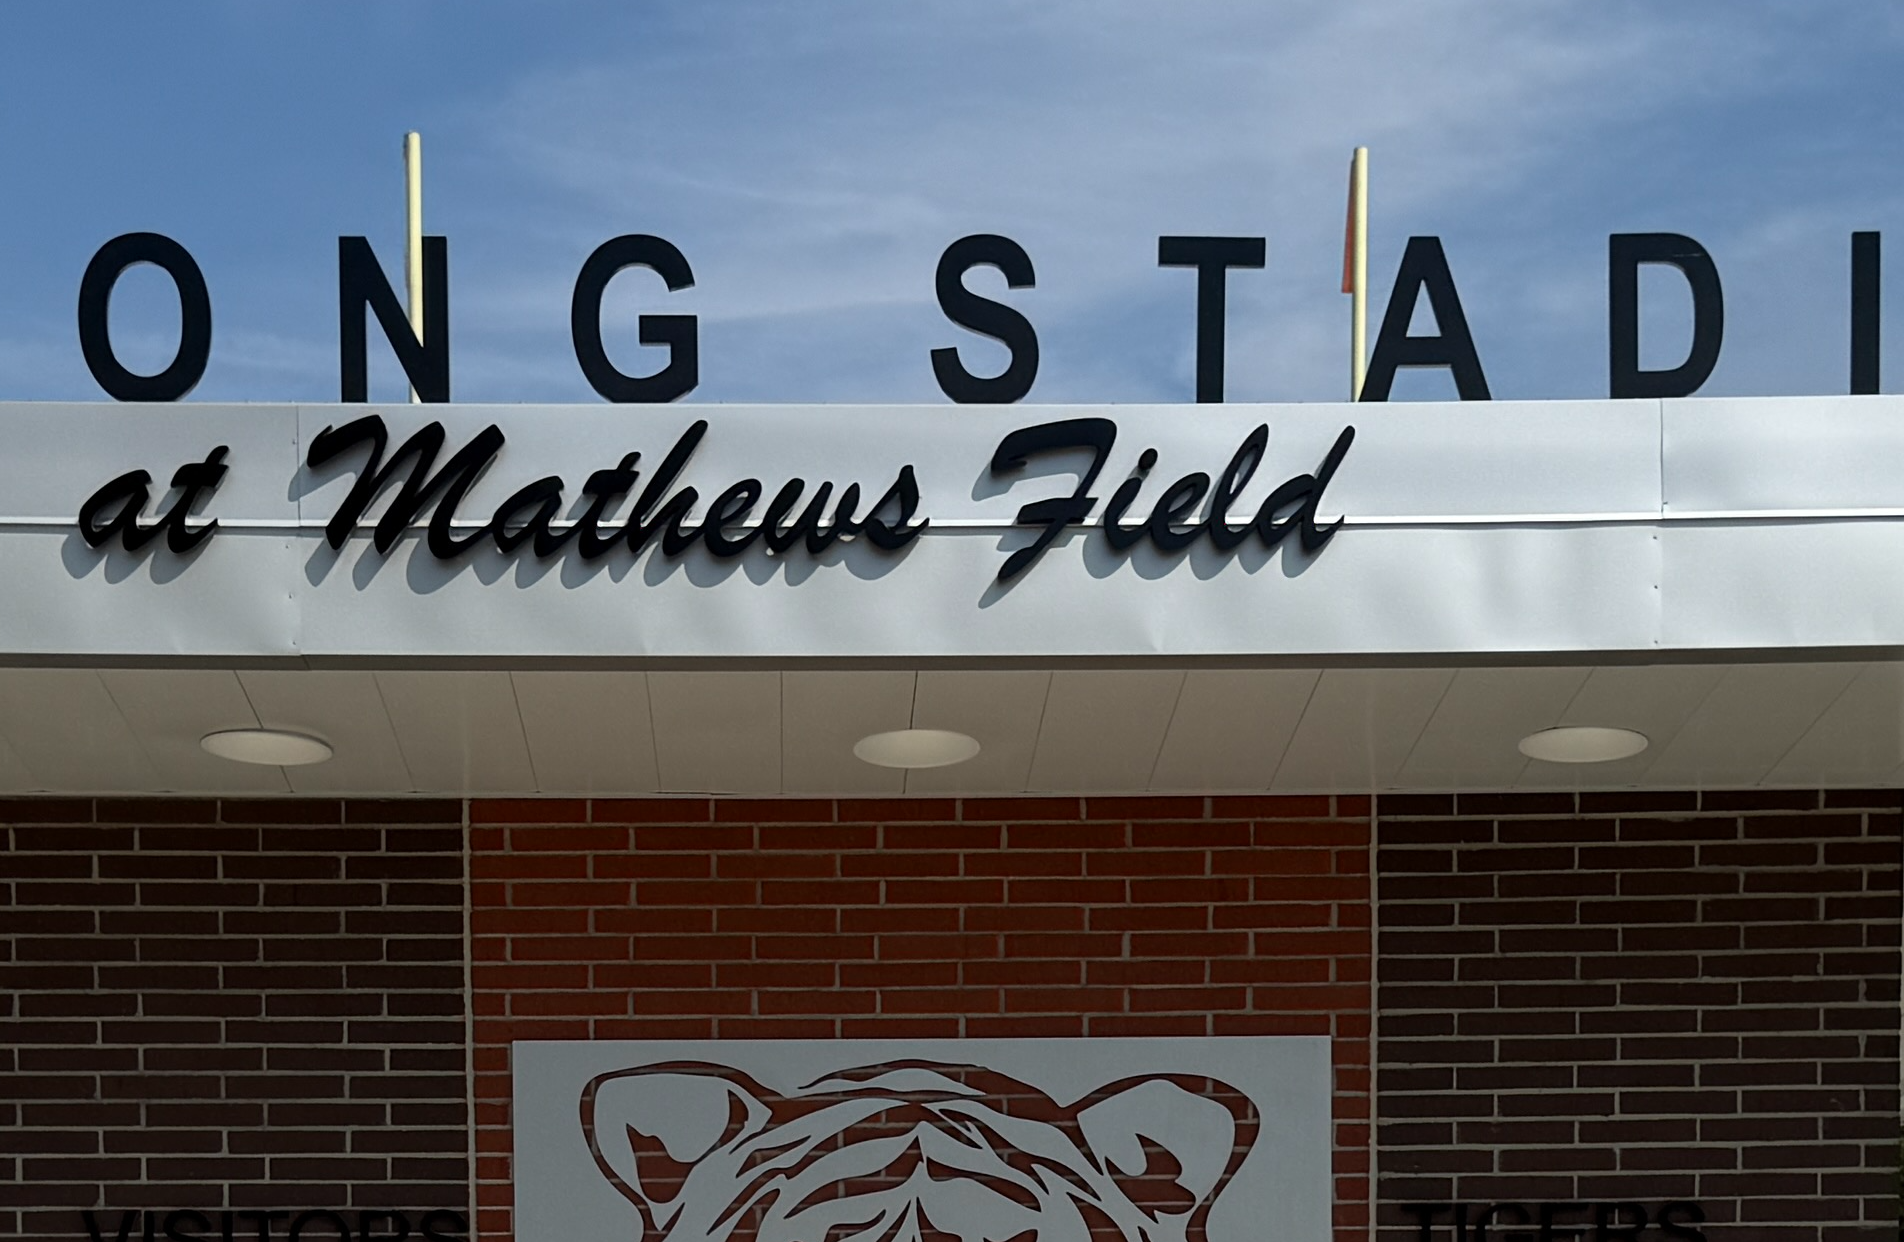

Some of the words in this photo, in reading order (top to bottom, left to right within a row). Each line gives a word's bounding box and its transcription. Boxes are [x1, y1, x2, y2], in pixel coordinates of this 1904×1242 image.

[78, 445, 229, 557] at
[304, 414, 930, 562] Mathews
[990, 417, 1356, 584] Field
